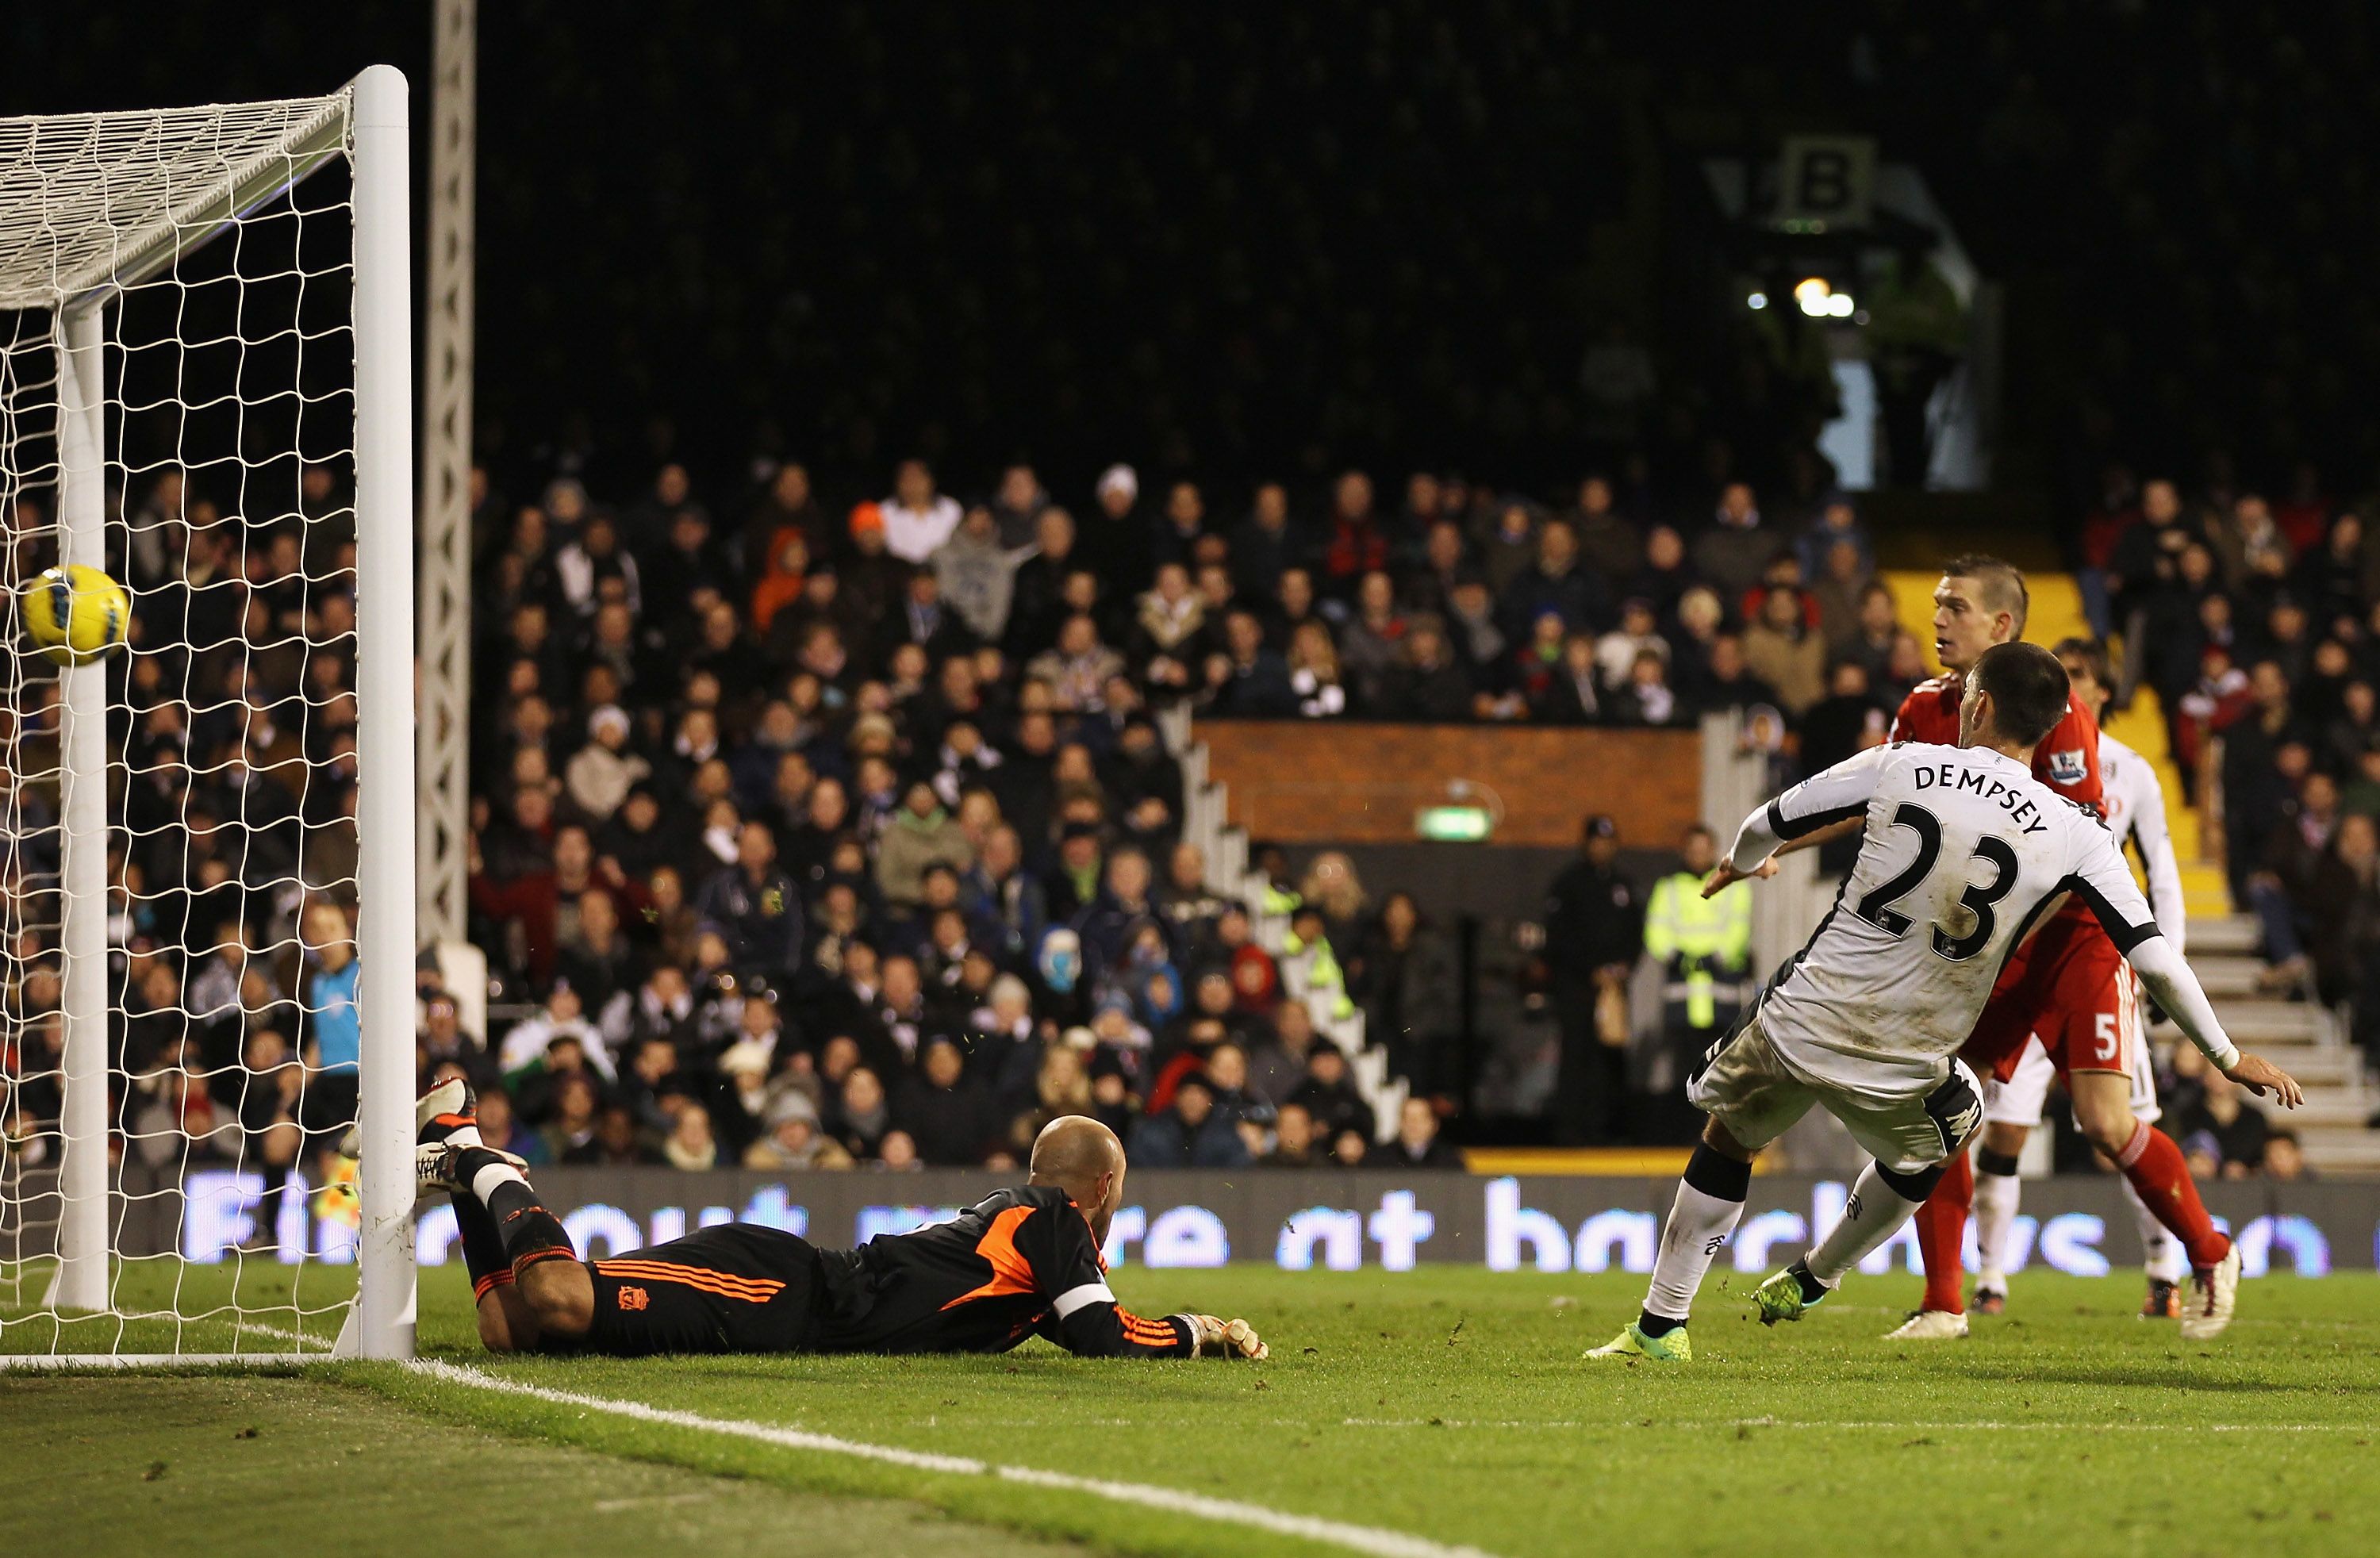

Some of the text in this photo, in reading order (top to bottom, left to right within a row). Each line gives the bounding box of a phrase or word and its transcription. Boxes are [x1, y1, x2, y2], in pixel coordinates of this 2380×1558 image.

[1802, 149, 1850, 210] B
[1914, 764, 2048, 835] DEMPSEY
[1853, 800, 2021, 962] 23
[2094, 1013, 2117, 1061] 5
[1276, 1188, 1434, 1272] at
